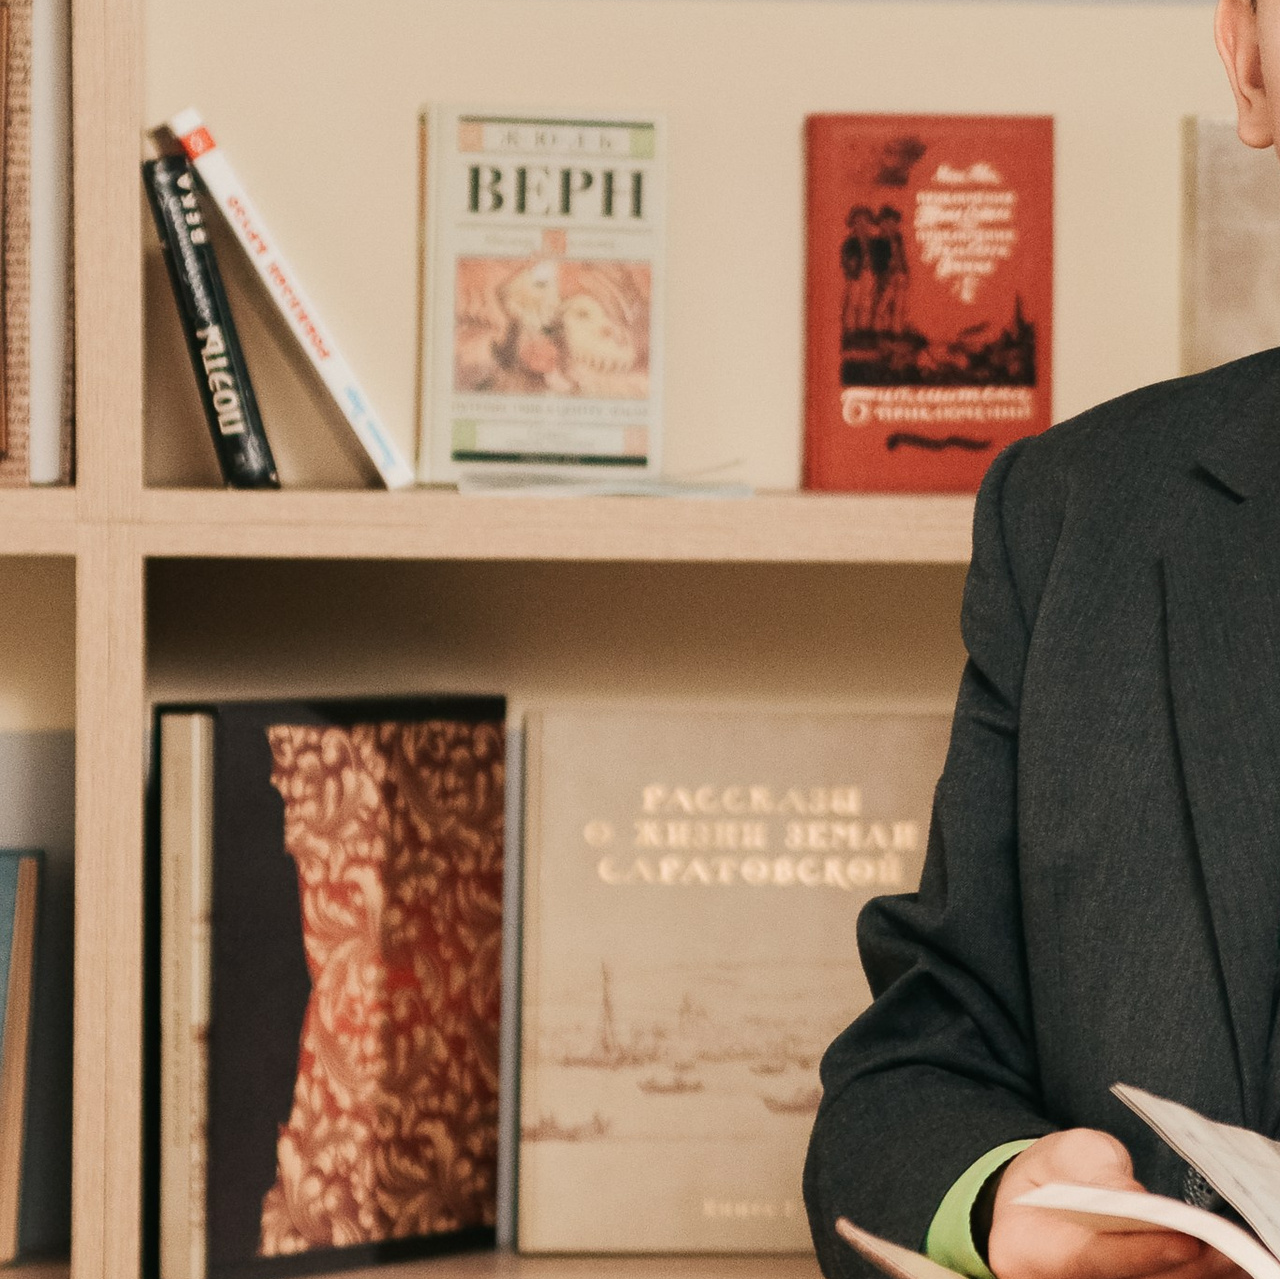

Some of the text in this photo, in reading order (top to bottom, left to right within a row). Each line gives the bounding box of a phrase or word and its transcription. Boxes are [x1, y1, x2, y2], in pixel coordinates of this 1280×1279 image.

[177, 172, 208, 246] ВЕКА
[466, 163, 645, 219] ВЕРН
[196, 324, 246, 437] ПОЭТЫ
[641, 785, 863, 816] РАССКАЗЫ
[583, 822, 613, 849] О
[633, 822, 767, 851] ЖИЗНИ
[597, 852, 903, 891] САРАТОВСКОЙ
